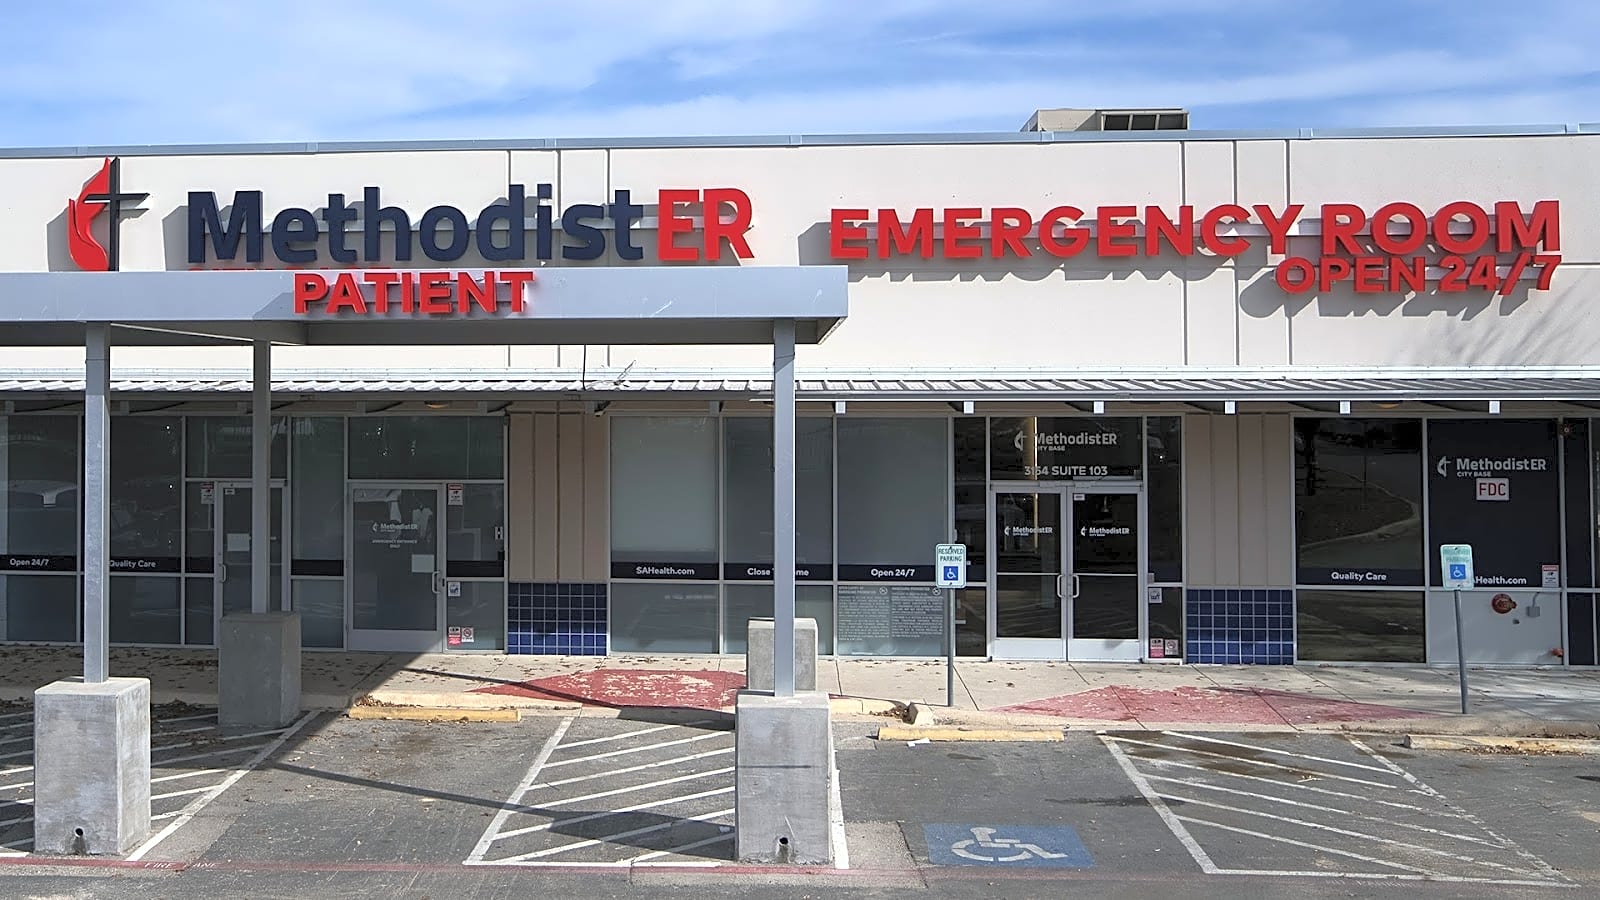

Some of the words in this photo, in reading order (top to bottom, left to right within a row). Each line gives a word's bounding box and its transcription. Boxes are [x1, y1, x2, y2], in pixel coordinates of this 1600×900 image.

[829, 204, 1304, 259] EMERGENCY
[1322, 200, 1561, 257] ROOM
[1276, 257, 1425, 295] OPEN
[1437, 254, 1562, 296] 24/7
[293, 271, 535, 315] PATIENT
[1456, 458, 1546, 470] MethodistER
[1051, 466, 1086, 476] SUITE
[1088, 466, 1108, 476] 103
[1479, 482, 1506, 496] FDC
[9, 558, 30, 567] Open
[31, 558, 50, 567] 24/7
[138, 560, 156, 568] Care
[635, 566, 695, 576] SAHealth.com
[747, 567, 771, 576] Close
[870, 568, 894, 578] Open
[895, 568, 916, 577] 24/7
[1331, 571, 1364, 582] Quality
[1366, 571, 1387, 581] Care
[1473, 575, 1527, 585] Health.com
